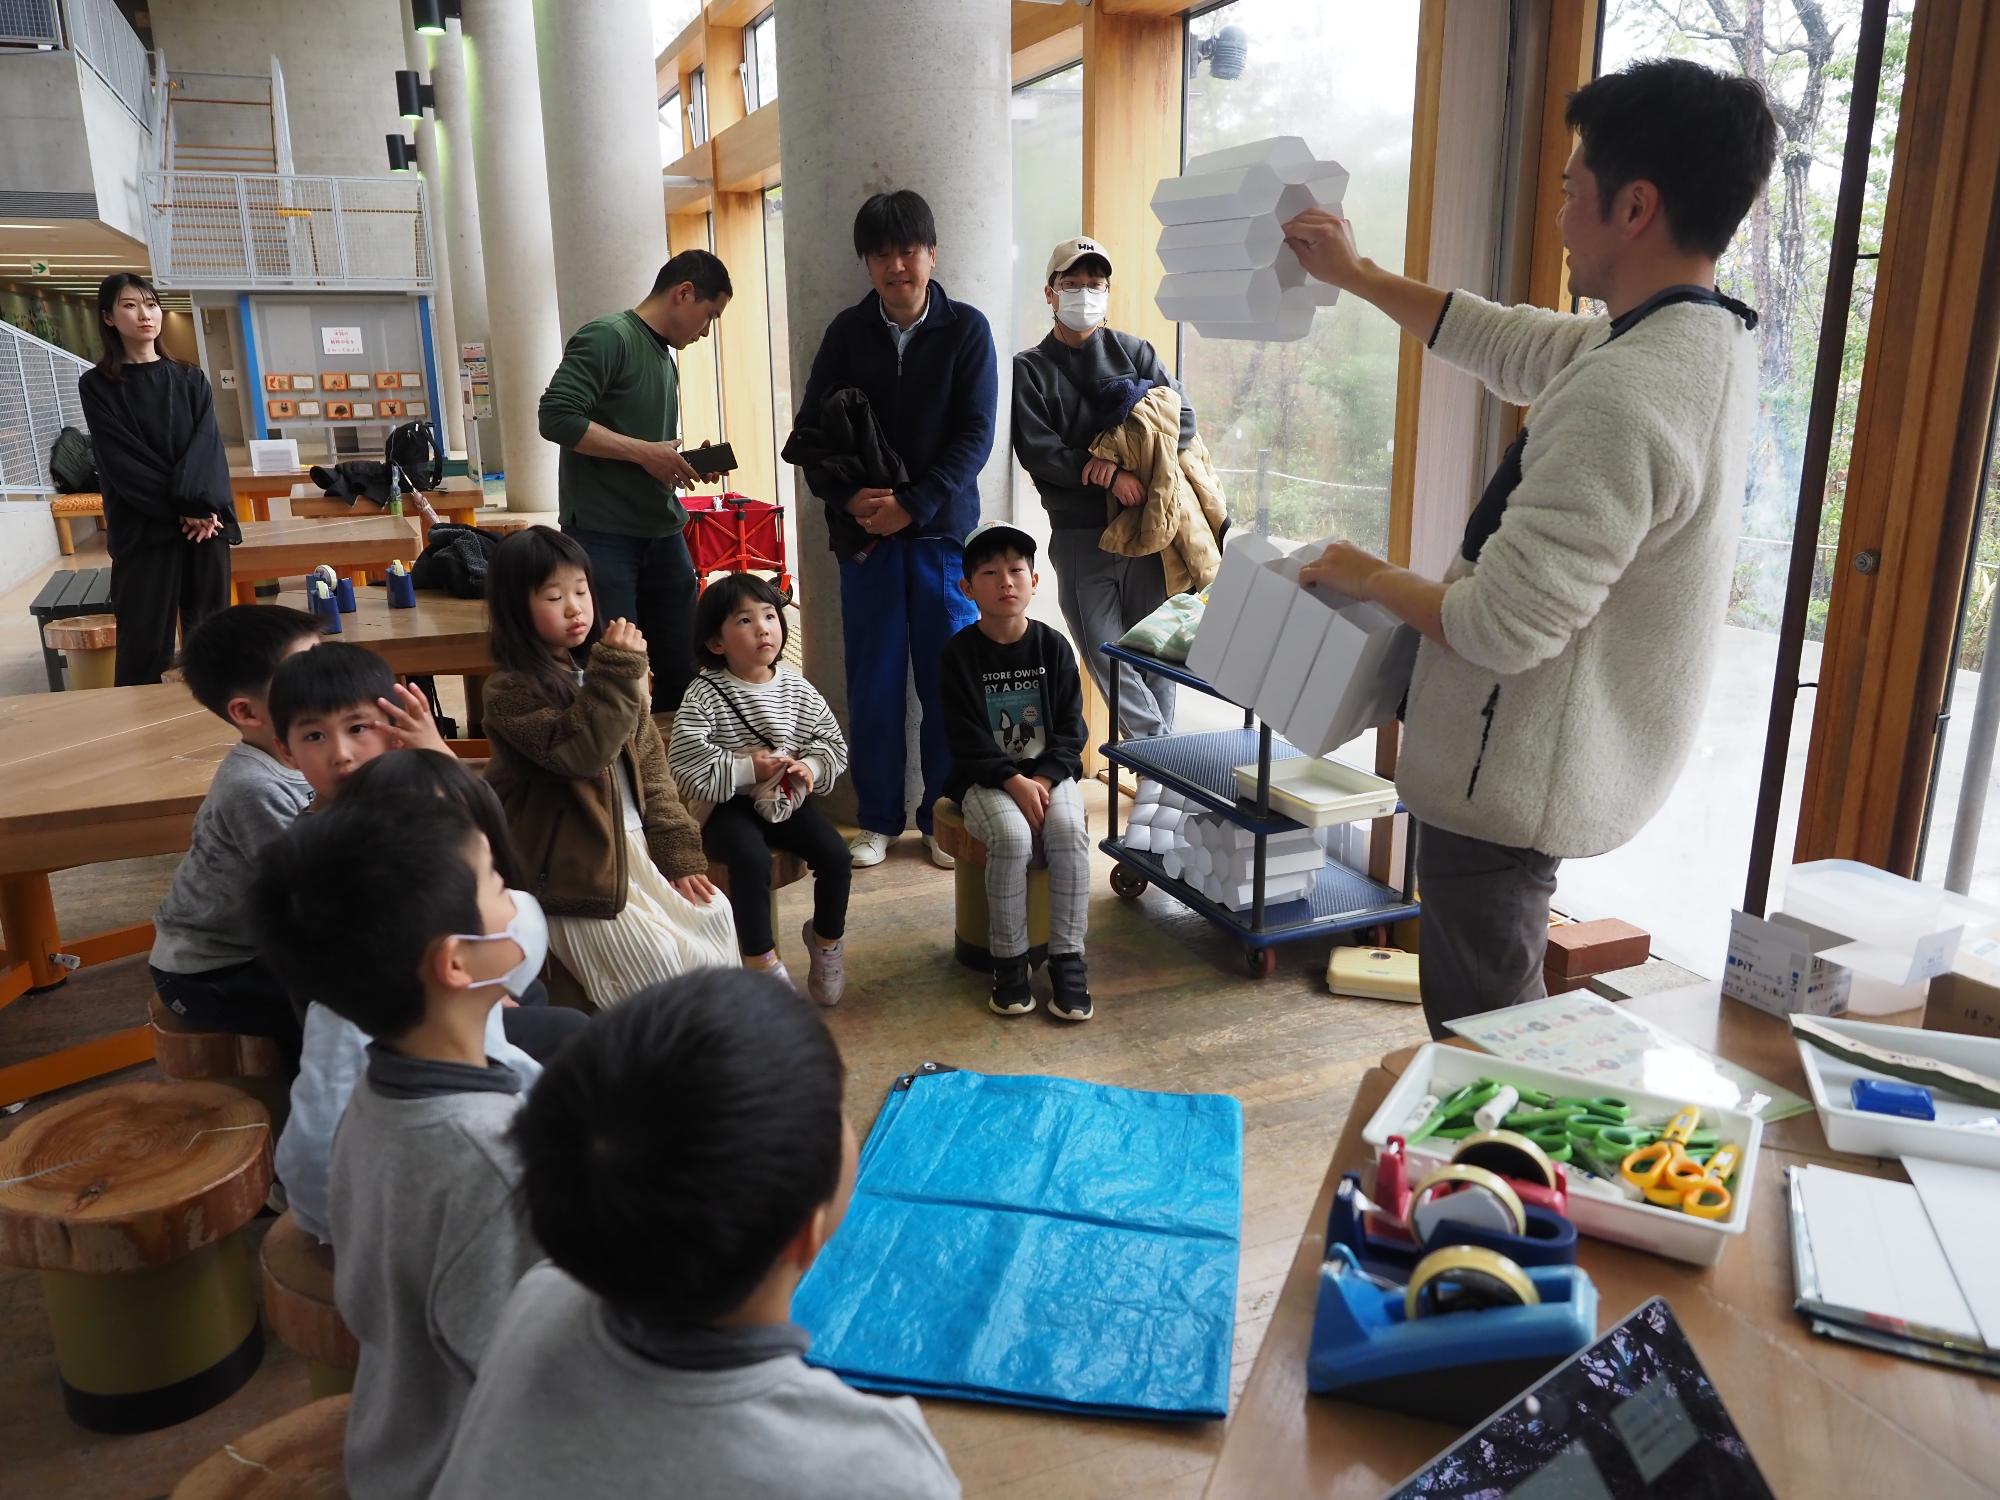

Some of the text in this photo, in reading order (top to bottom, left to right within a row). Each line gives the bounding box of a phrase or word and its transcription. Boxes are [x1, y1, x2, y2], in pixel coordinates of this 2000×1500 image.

[1078, 243, 1095, 251] HH
[982, 671, 1012, 682] STORE
[984, 680, 1039, 695] BY A DOG
